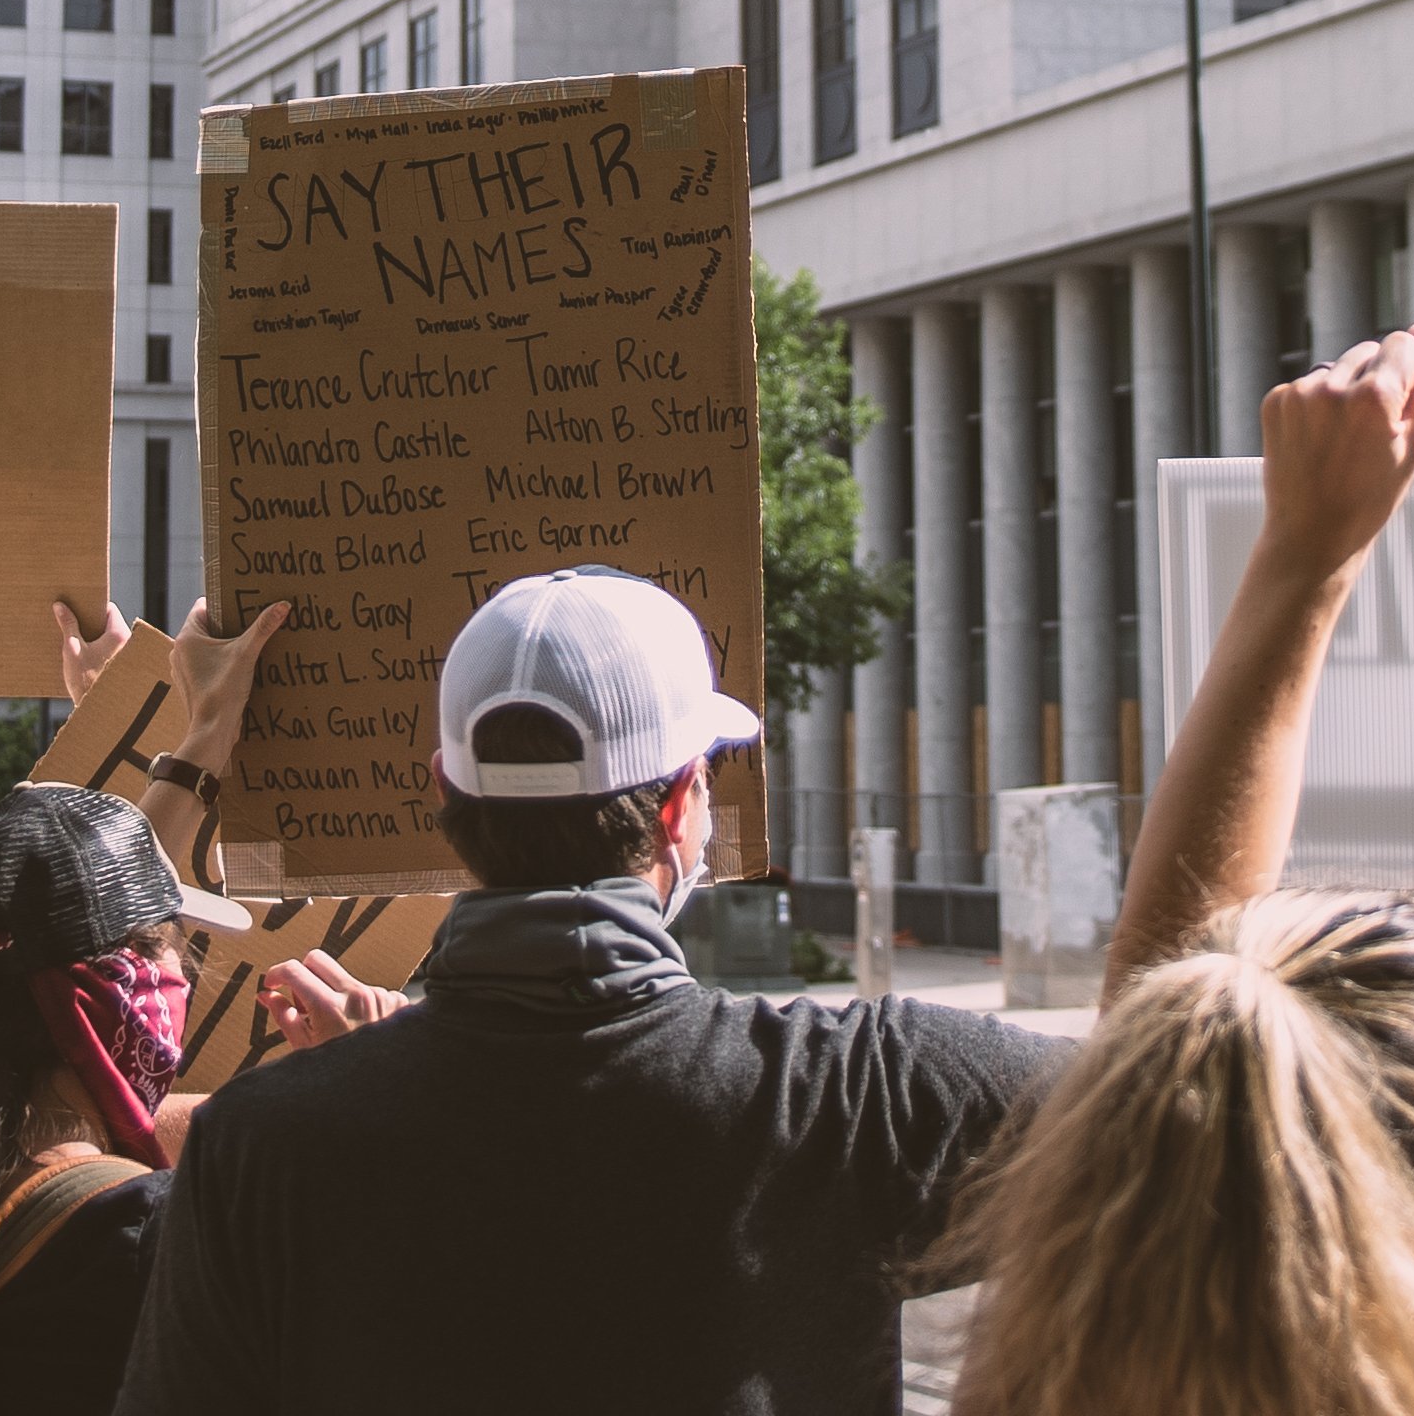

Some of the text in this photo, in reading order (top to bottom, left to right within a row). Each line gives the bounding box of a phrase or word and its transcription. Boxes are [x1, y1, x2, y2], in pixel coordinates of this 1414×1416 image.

[294, 129, 325, 146] Ford
[346, 122, 409, 144] Mya Hall
[426, 119, 463, 134] India
[257, 123, 640, 251] SAY THEIR
[372, 217, 592, 305] NAMES
[620, 224, 732, 260] Troy Robinson
[280, 275, 312, 297] Reid
[559, 291, 600, 310] Junior
[318, 308, 362, 331] Taylor
[219, 349, 498, 412] Terence Crutcher
[506, 331, 688, 396] Tamir Rice
[228, 419, 471, 467] Philandro Castile
[525, 395, 751, 450] Alton B. Sterling
[230, 474, 447, 523] Samuel DuBose
[485, 460, 715, 503] Michael Brown
[230, 529, 427, 576] Sandra Bland
[468, 516, 637, 554] Eric Garner
[234, 589, 412, 640] Fddie Gray
[337, 651, 368, 684] L.
[371, 644, 446, 683] Scott
[327, 703, 419, 747] Gurley
